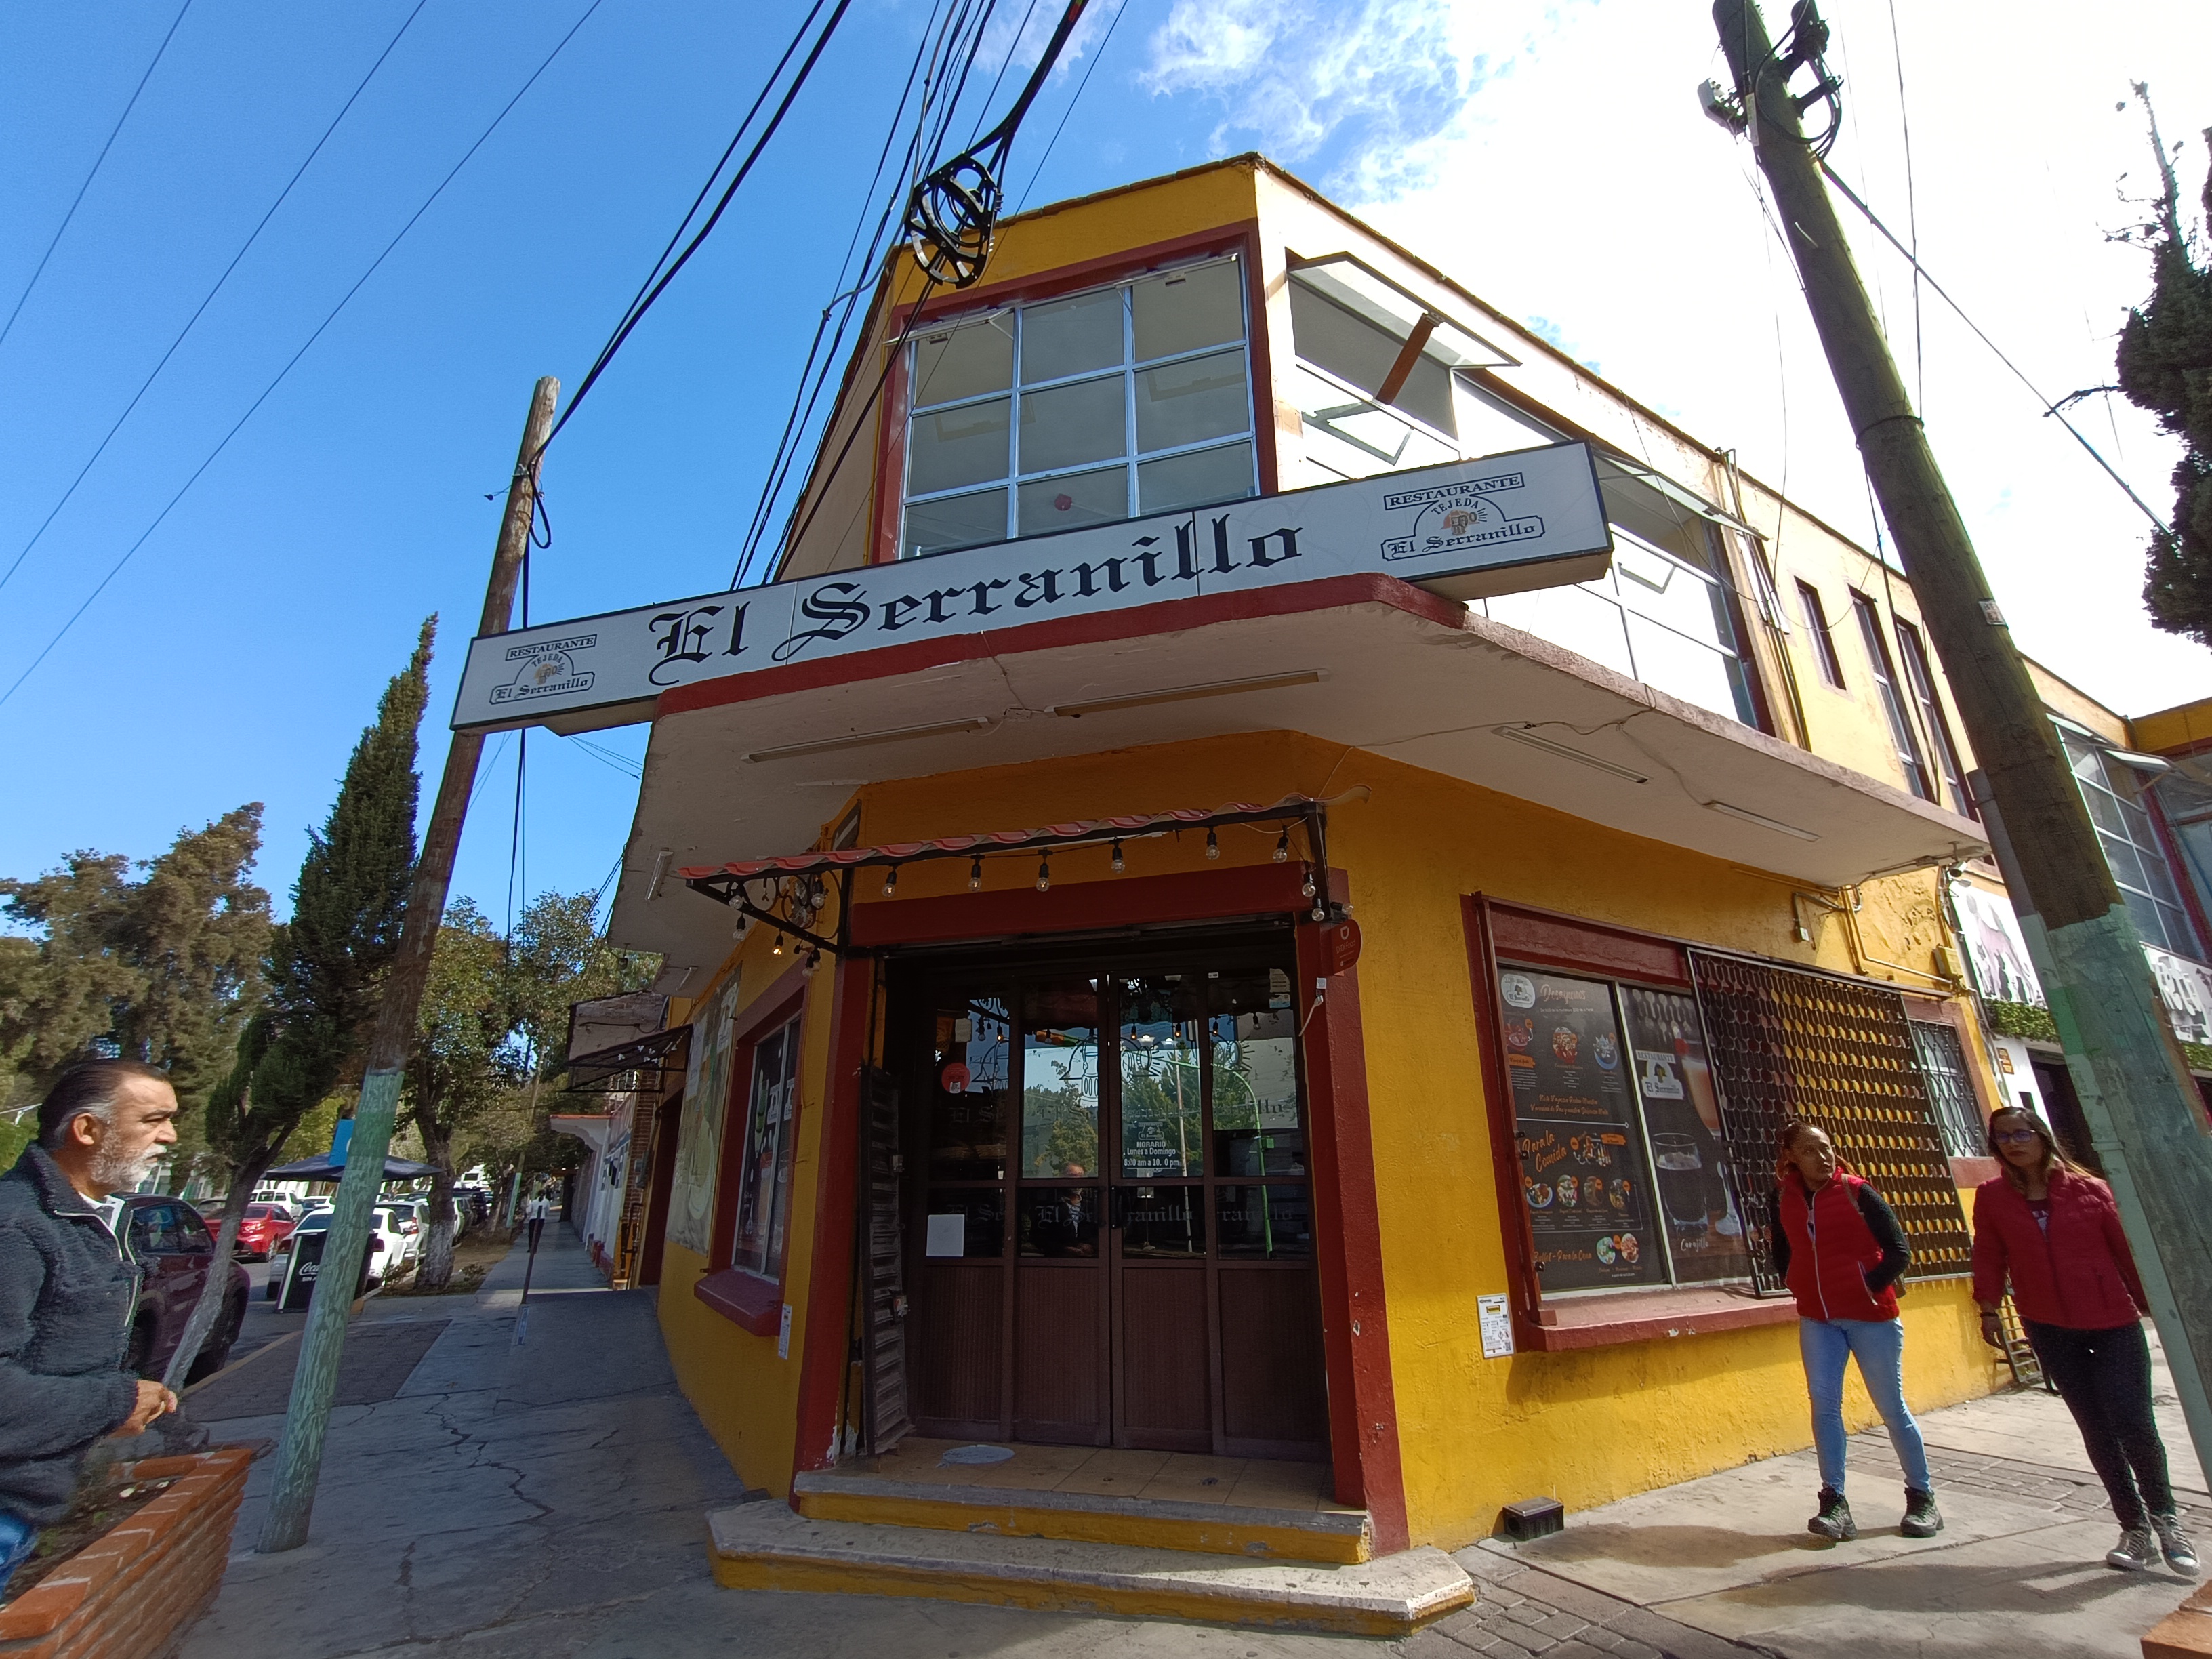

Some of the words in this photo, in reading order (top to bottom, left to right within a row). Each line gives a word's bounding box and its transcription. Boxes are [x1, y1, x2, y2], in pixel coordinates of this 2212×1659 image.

[1389, 476, 1520, 506] RESTAURANTE
[1431, 498, 1479, 515] TEJEDA
[1387, 540, 1416, 558] El
[1422, 523, 1536, 552] Serranillo
[648, 600, 751, 687] El
[771, 513, 1303, 663] Serranillo
[510, 637, 594, 657] RESTAURANTE
[531, 653, 563, 668] TEJEDA
[495, 687, 512, 703] El
[515, 678, 589, 699] Serranillo
[1149, 1147, 1176, 1157] Domingo
[1522, 1137, 1545, 1153] Para
[1546, 1130, 1555, 1146] la
[1535, 1143, 1568, 1172] Comida
